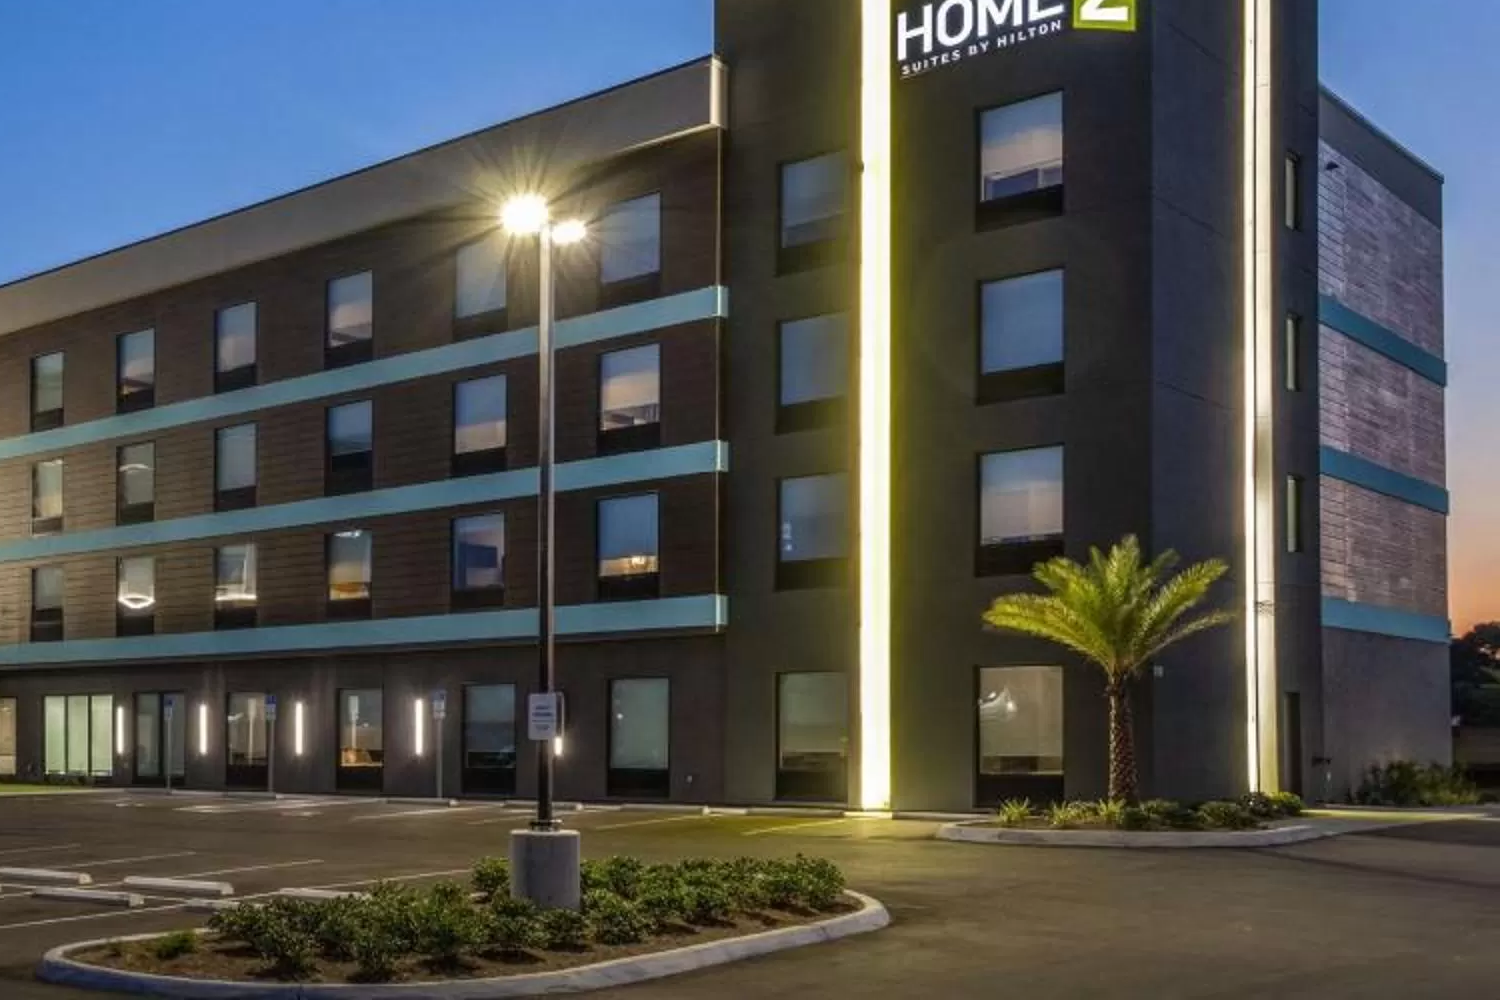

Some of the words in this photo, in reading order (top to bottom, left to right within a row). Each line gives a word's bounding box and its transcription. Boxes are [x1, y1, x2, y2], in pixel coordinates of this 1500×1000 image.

[901, 49, 961, 75] SUITES
[969, 41, 989, 56] BY
[997, 20, 1062, 48] HILTON
